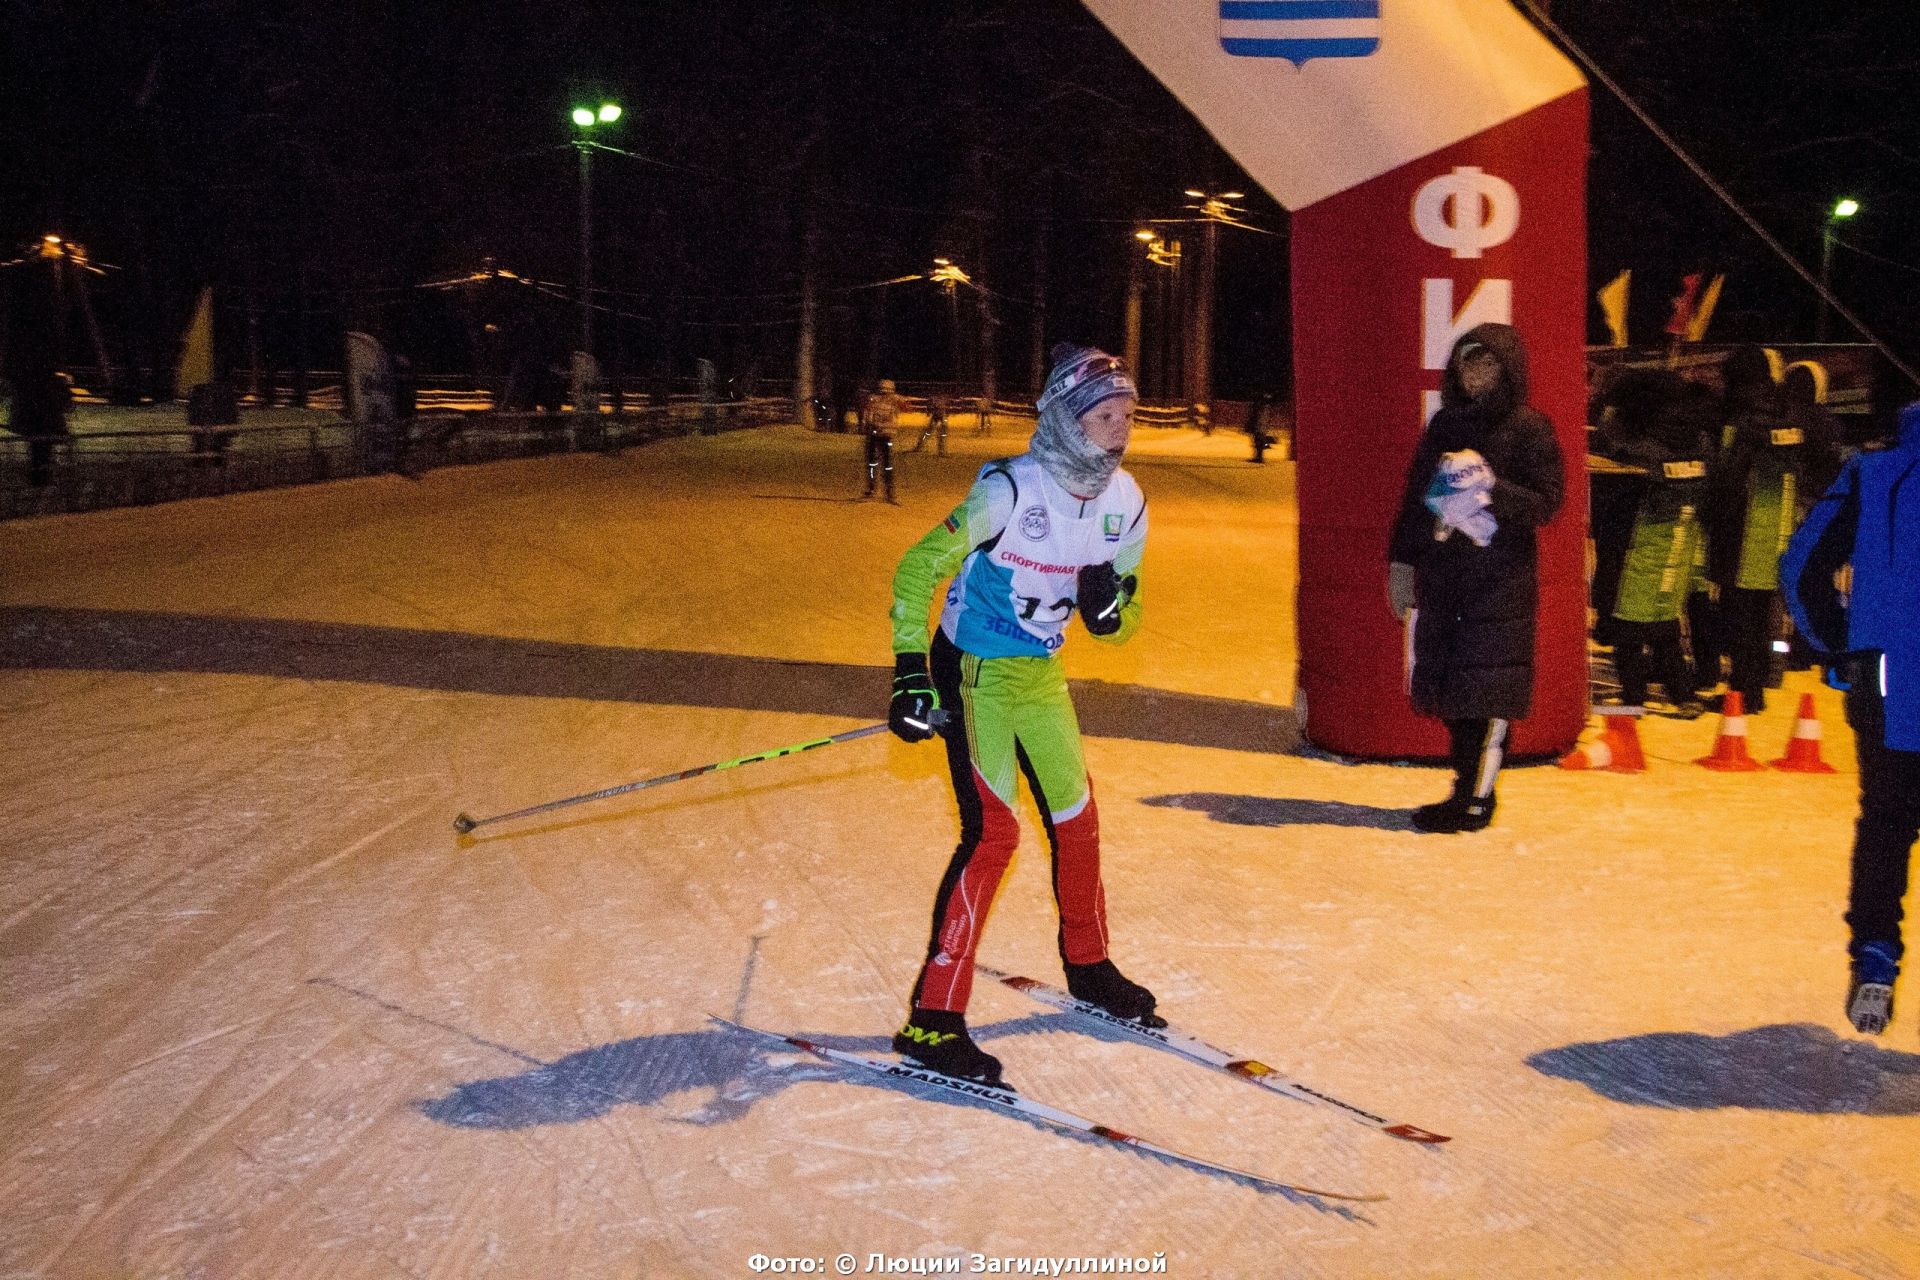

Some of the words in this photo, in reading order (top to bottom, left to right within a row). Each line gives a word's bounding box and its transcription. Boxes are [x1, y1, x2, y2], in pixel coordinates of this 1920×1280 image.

[1410, 166, 1520, 427] ФИ
[1000, 551, 1075, 574] СПОРТИВНАЯ
[1073, 1003, 1168, 1041] MADSHUS
[886, 1067, 1019, 1106] MADSHUS
